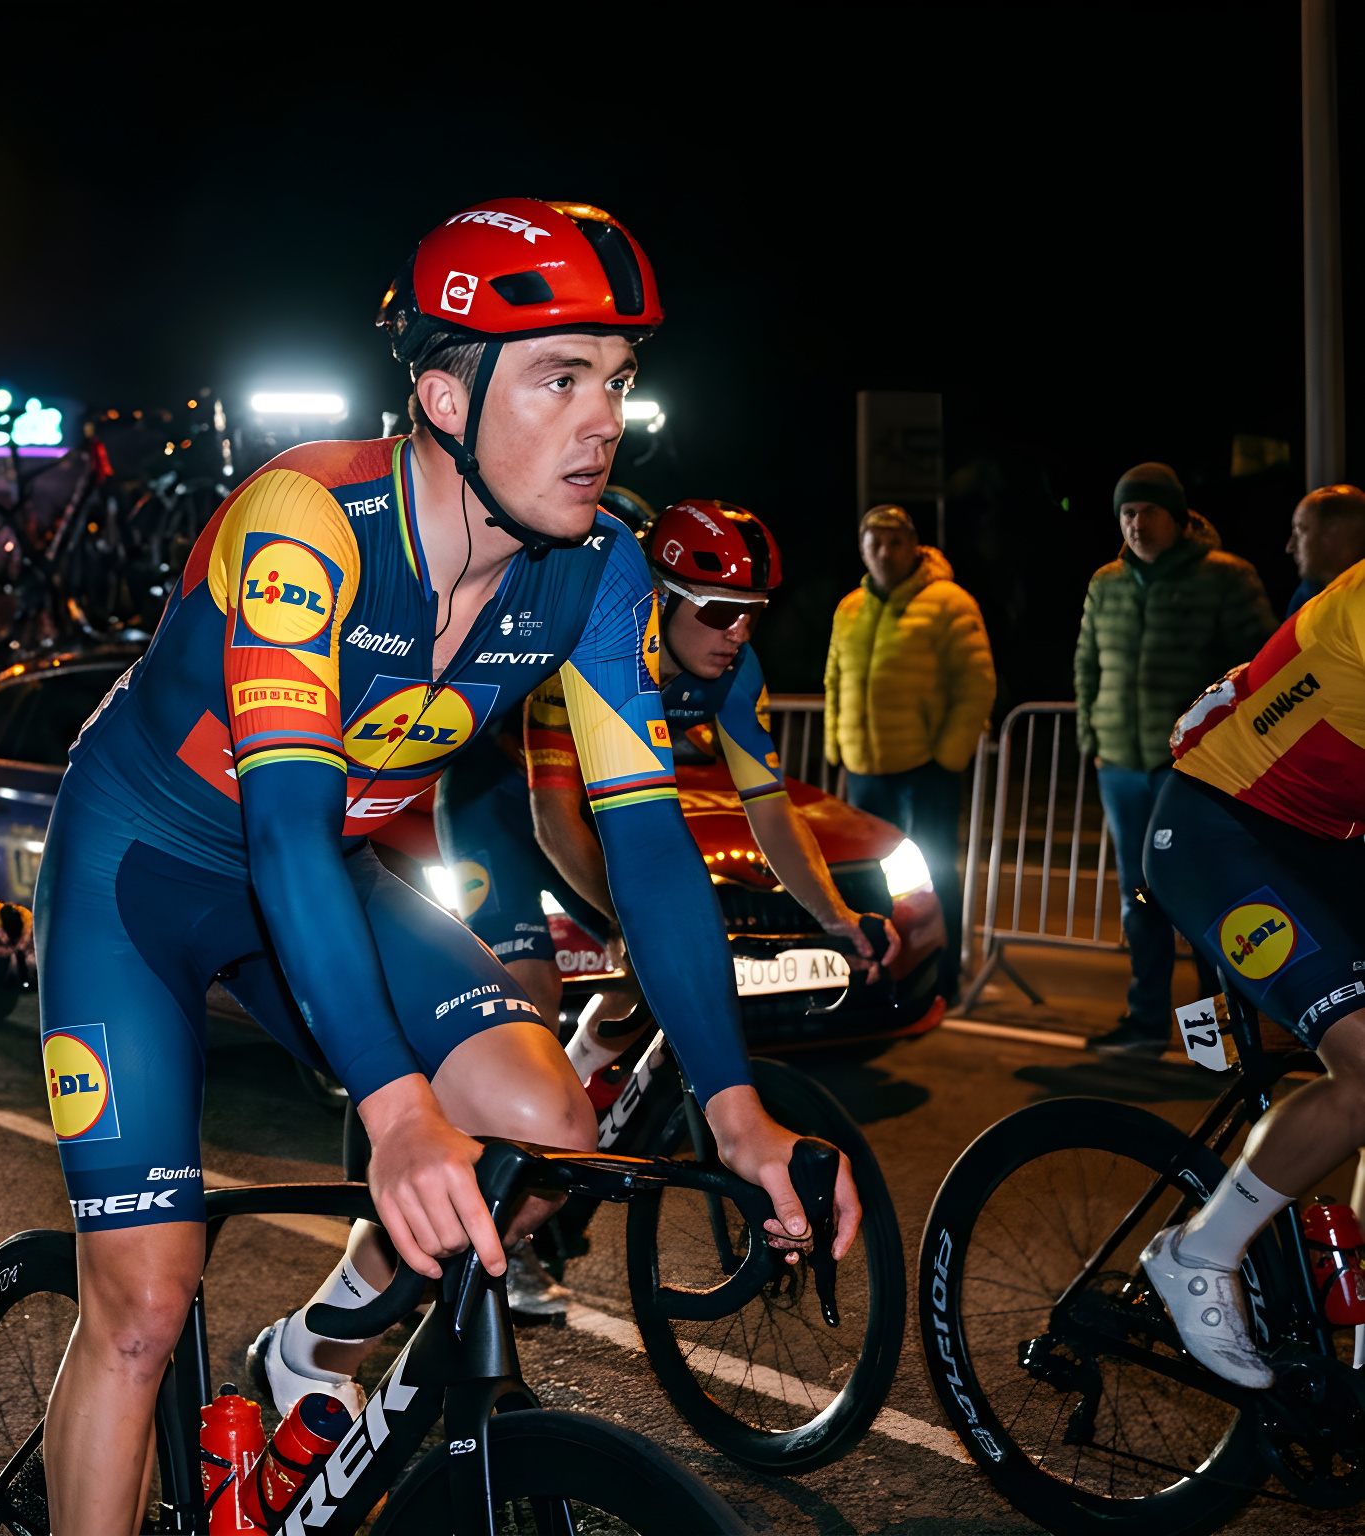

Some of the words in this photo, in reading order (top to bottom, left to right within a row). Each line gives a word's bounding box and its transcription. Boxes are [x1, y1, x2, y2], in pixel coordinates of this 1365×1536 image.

[446, 210, 552, 244] TREK
[344, 493, 390, 517] TREK
[275, 1343, 420, 1536] REK
